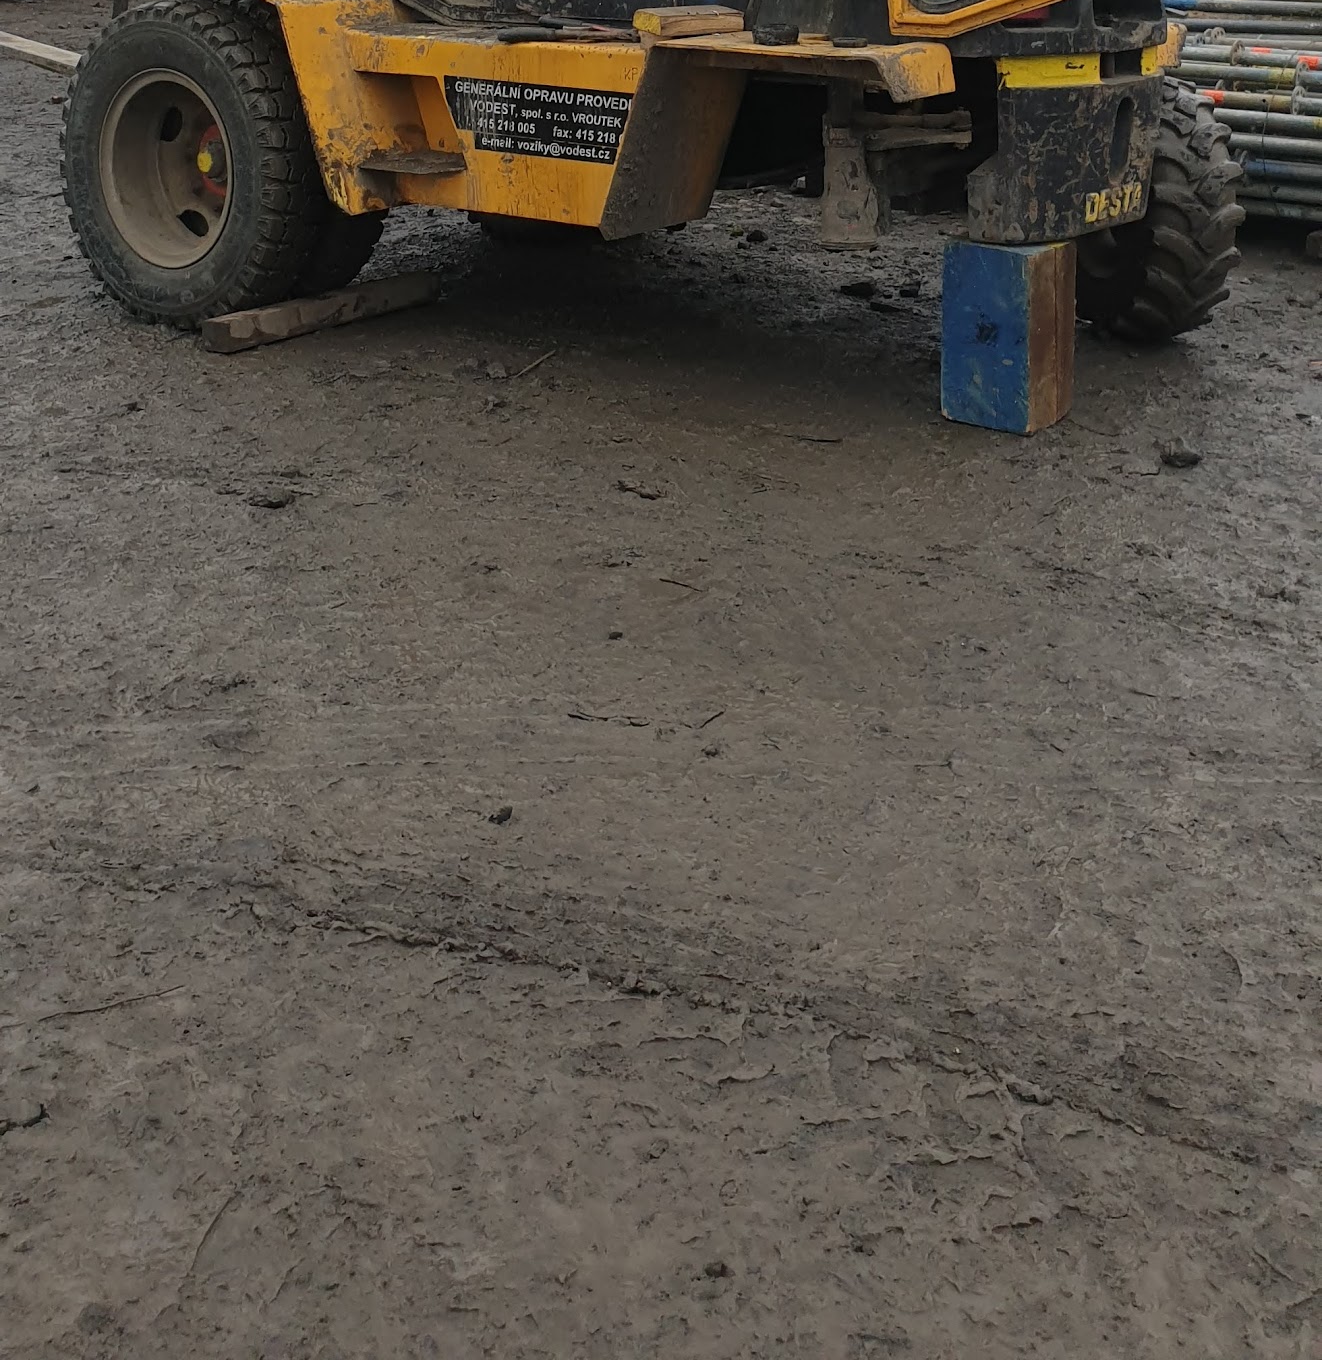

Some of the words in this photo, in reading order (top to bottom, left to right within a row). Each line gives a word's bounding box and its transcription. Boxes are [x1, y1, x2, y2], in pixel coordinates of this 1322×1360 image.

[455, 80, 521, 99] GENERÁLNÍ
[524, 88, 575, 105] OPRAVU
[470, 99, 518, 118] VODEST,
[521, 107, 543, 120] spol.
[546, 112, 551, 120] s
[554, 113, 569, 122] r.o.
[572, 112, 622, 129] VROUTEK
[477, 116, 495, 129] 415
[497, 118, 515, 132] 218
[517, 122, 536, 134] 005
[552, 125, 573, 139] fax:
[575, 128, 594, 142] 415
[597, 130, 616, 144] 218
[481, 135, 515, 149] e-mail:
[517, 139, 611, 160] voziky@vodest.cz
[1084, 183, 1142, 224] DESTA
